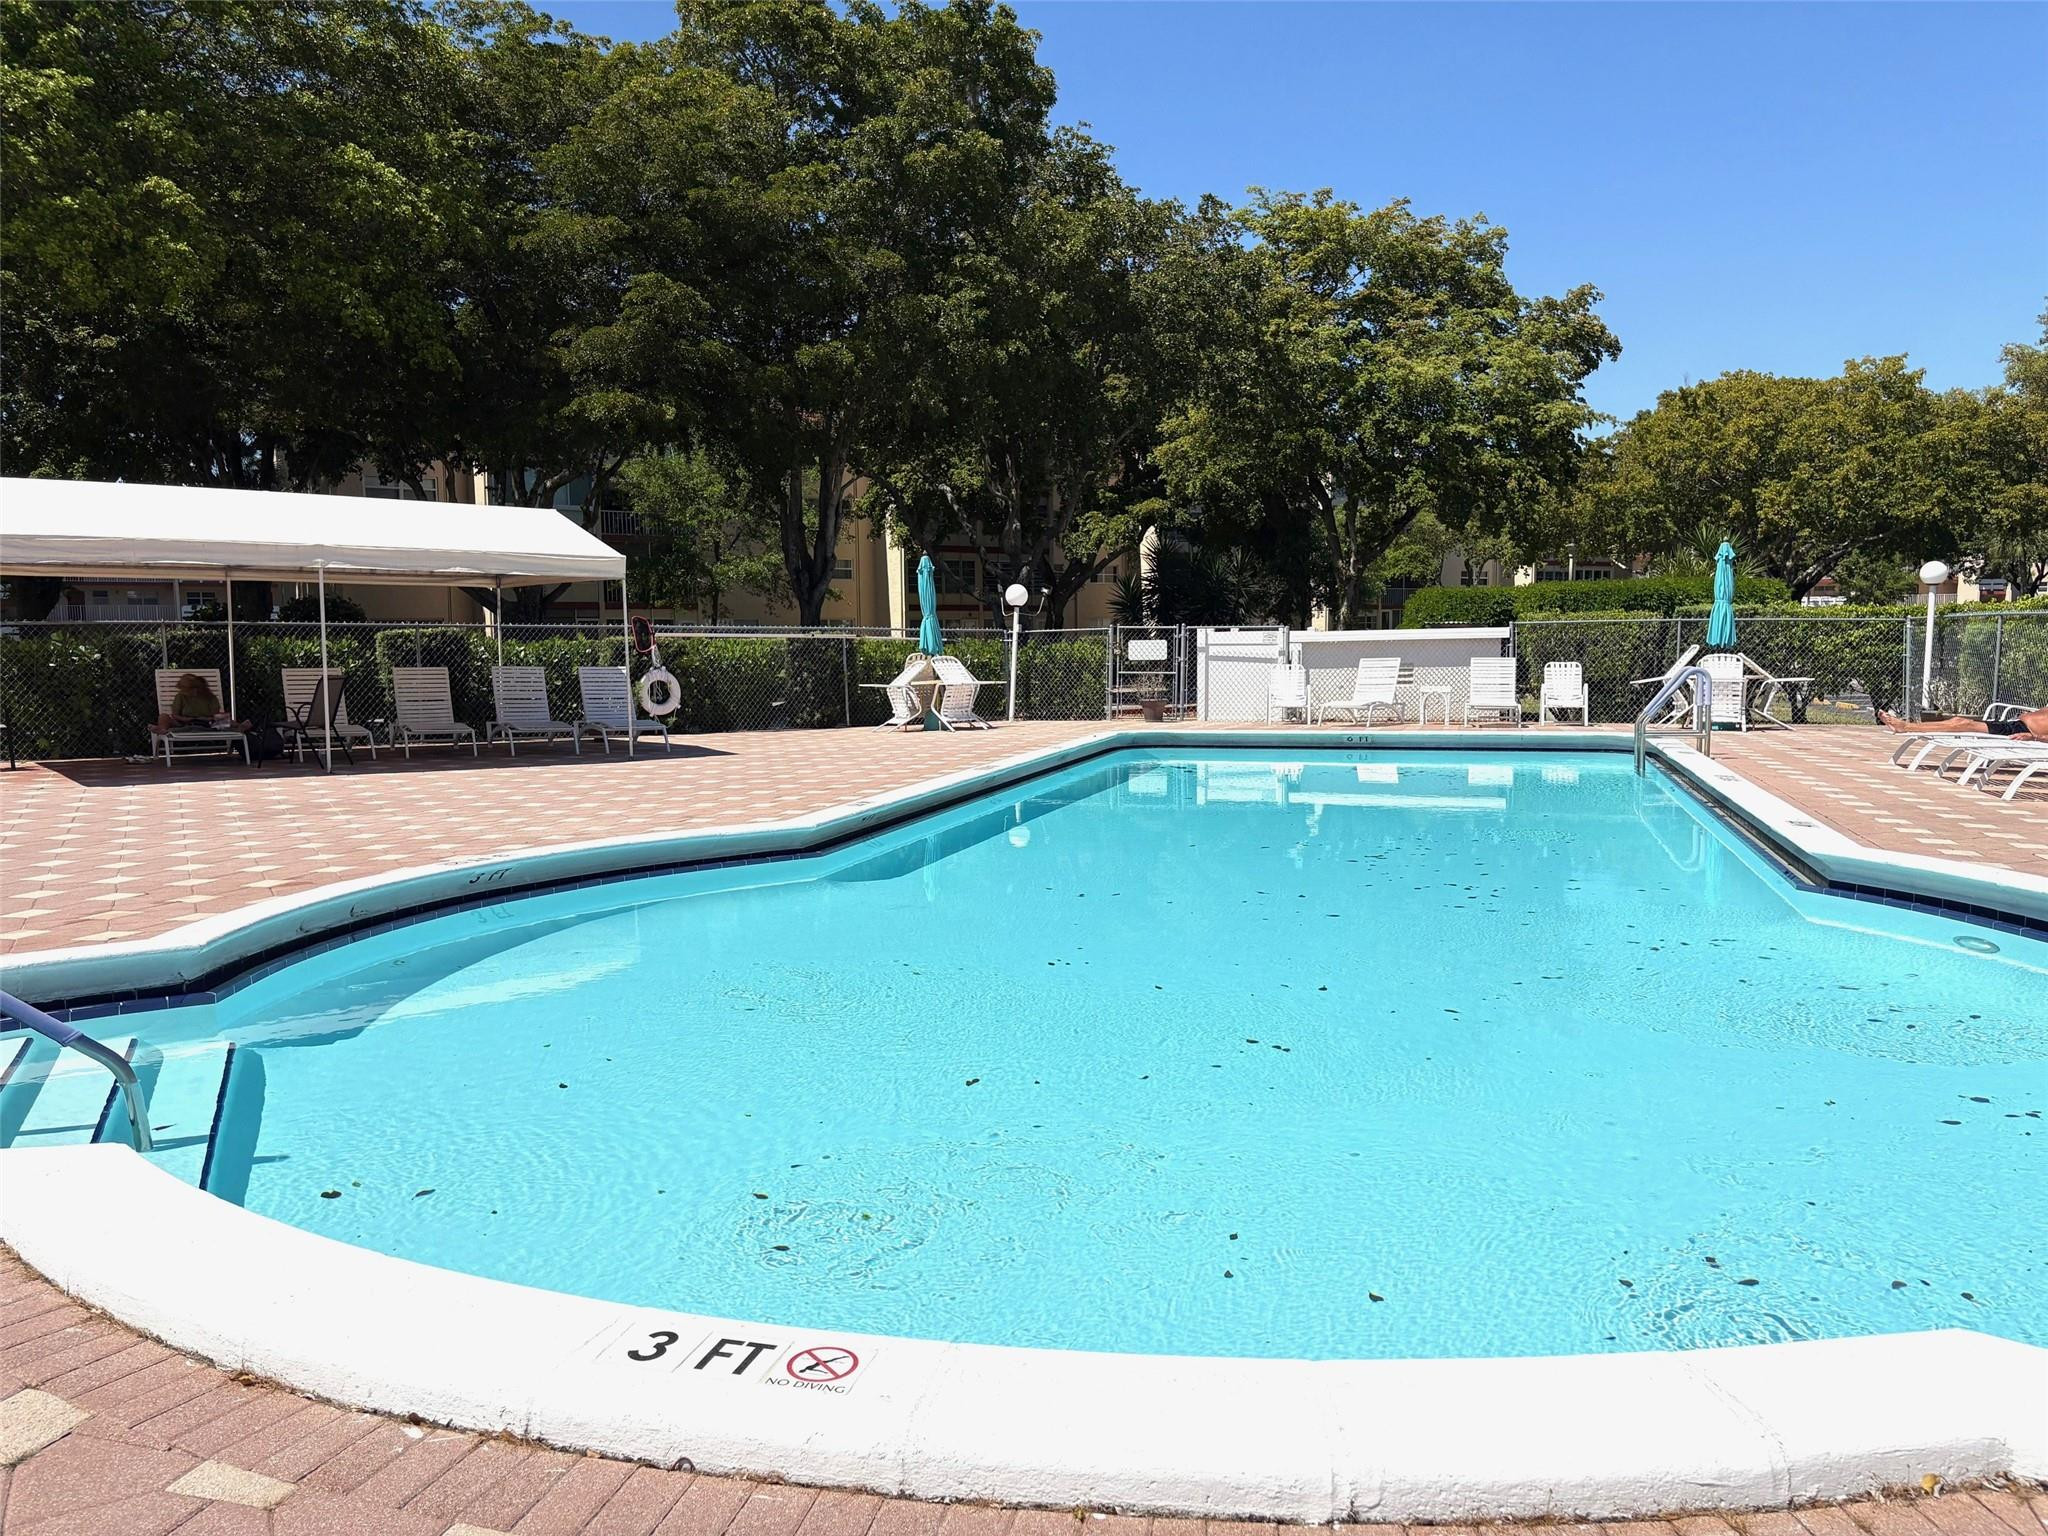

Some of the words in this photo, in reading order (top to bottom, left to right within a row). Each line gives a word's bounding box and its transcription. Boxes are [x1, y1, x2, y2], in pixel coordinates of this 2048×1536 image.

[627, 1331, 679, 1361] 3
[693, 1338, 778, 1375] FT
[765, 1377, 790, 1386] NO
[793, 1380, 845, 1394] DIVING
